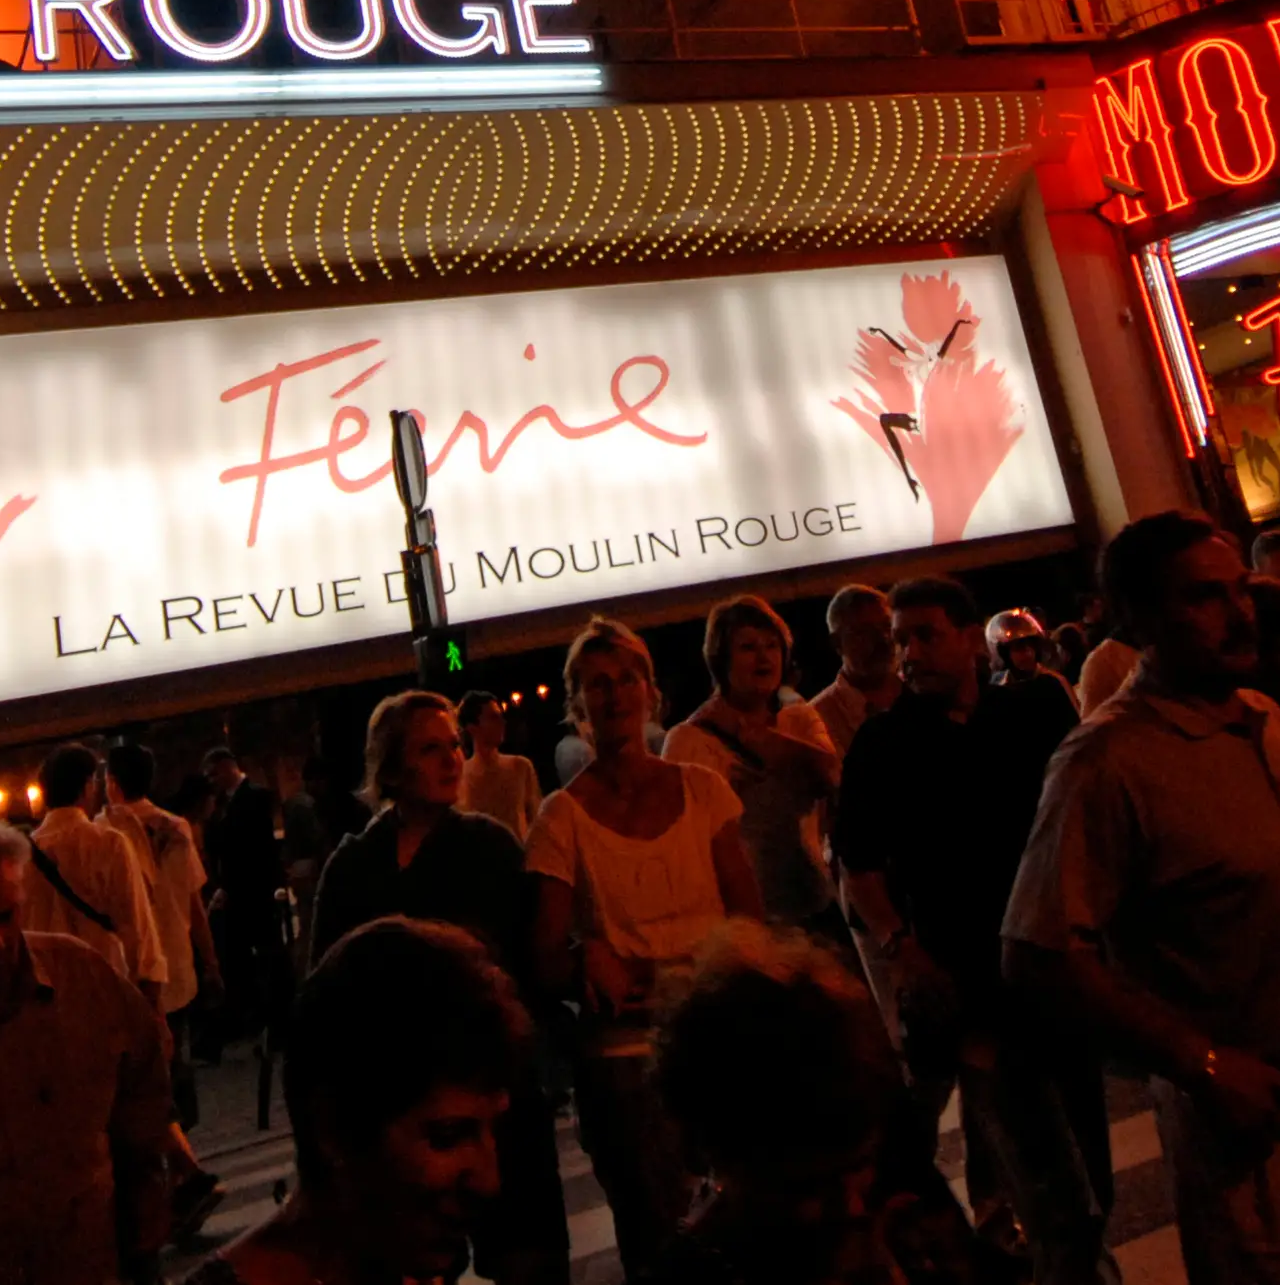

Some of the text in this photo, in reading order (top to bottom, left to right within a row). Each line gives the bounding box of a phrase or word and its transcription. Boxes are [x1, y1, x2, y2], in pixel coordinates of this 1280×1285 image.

[163, 580, 365, 640] REVUE
[477, 527, 680, 589] MOULIN
[696, 502, 862, 554] ROUGE
